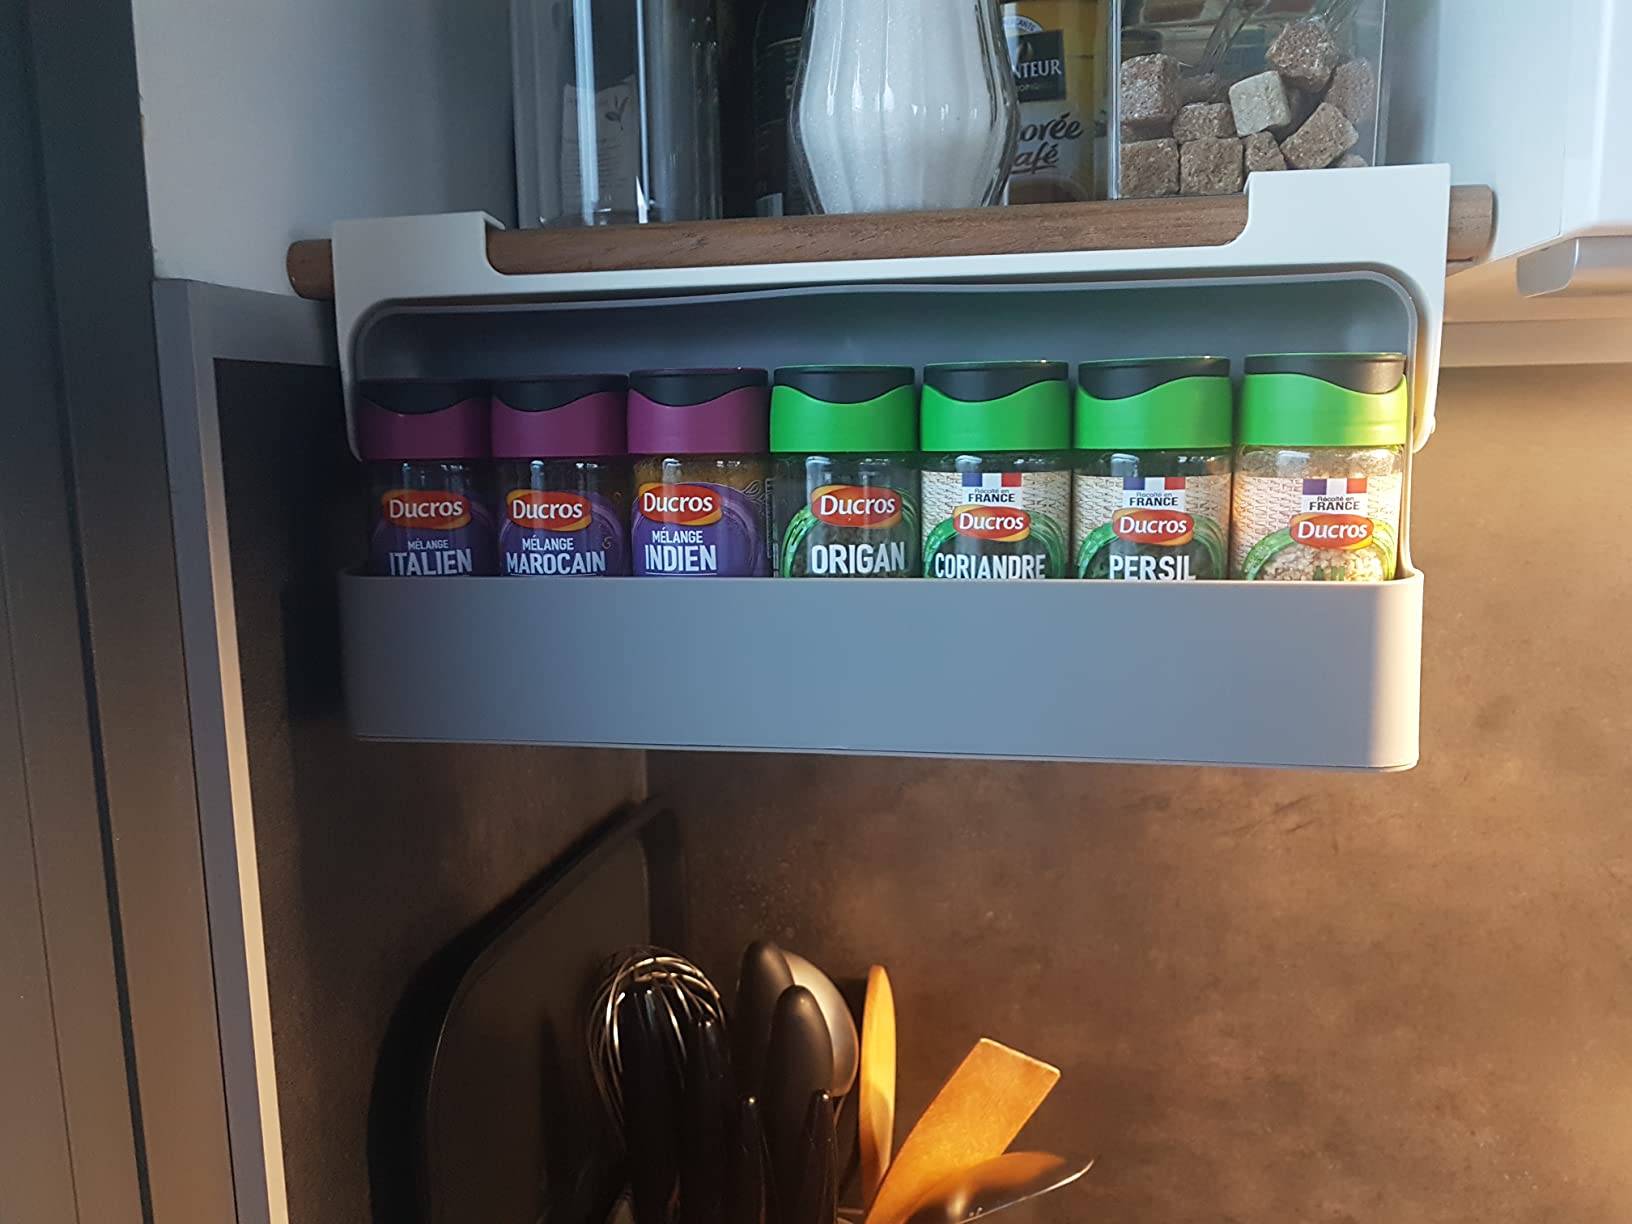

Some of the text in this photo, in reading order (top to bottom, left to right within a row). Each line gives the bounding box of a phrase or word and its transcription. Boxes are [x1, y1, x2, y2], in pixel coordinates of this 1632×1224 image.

[643, 492, 713, 513] Ducros
[820, 494, 896, 515] Ducros
[968, 493, 1016, 503] FRANCE
[1129, 497, 1179, 507] FRANCE
[1309, 501, 1360, 511] FRANCE
[389, 499, 463, 519] Ducros
[512, 499, 583, 520] Ducros
[959, 512, 1024, 530] Ducros
[1119, 516, 1188, 534] Ducros
[1297, 521, 1368, 539] Ducros
[407, 538, 449, 551] MÉLANGE
[521, 535, 574, 551] MÉLANGE
[651, 526, 704, 544] MÉLANGE
[388, 548, 473, 576] ITALIEN
[506, 551, 606, 575] MAROCAIN
[644, 544, 717, 572] INDIEN
[811, 541, 905, 575] ORIGAN
[934, 552, 1046, 579] CORIANDRE
[1109, 555, 1197, 580] PERSIL
